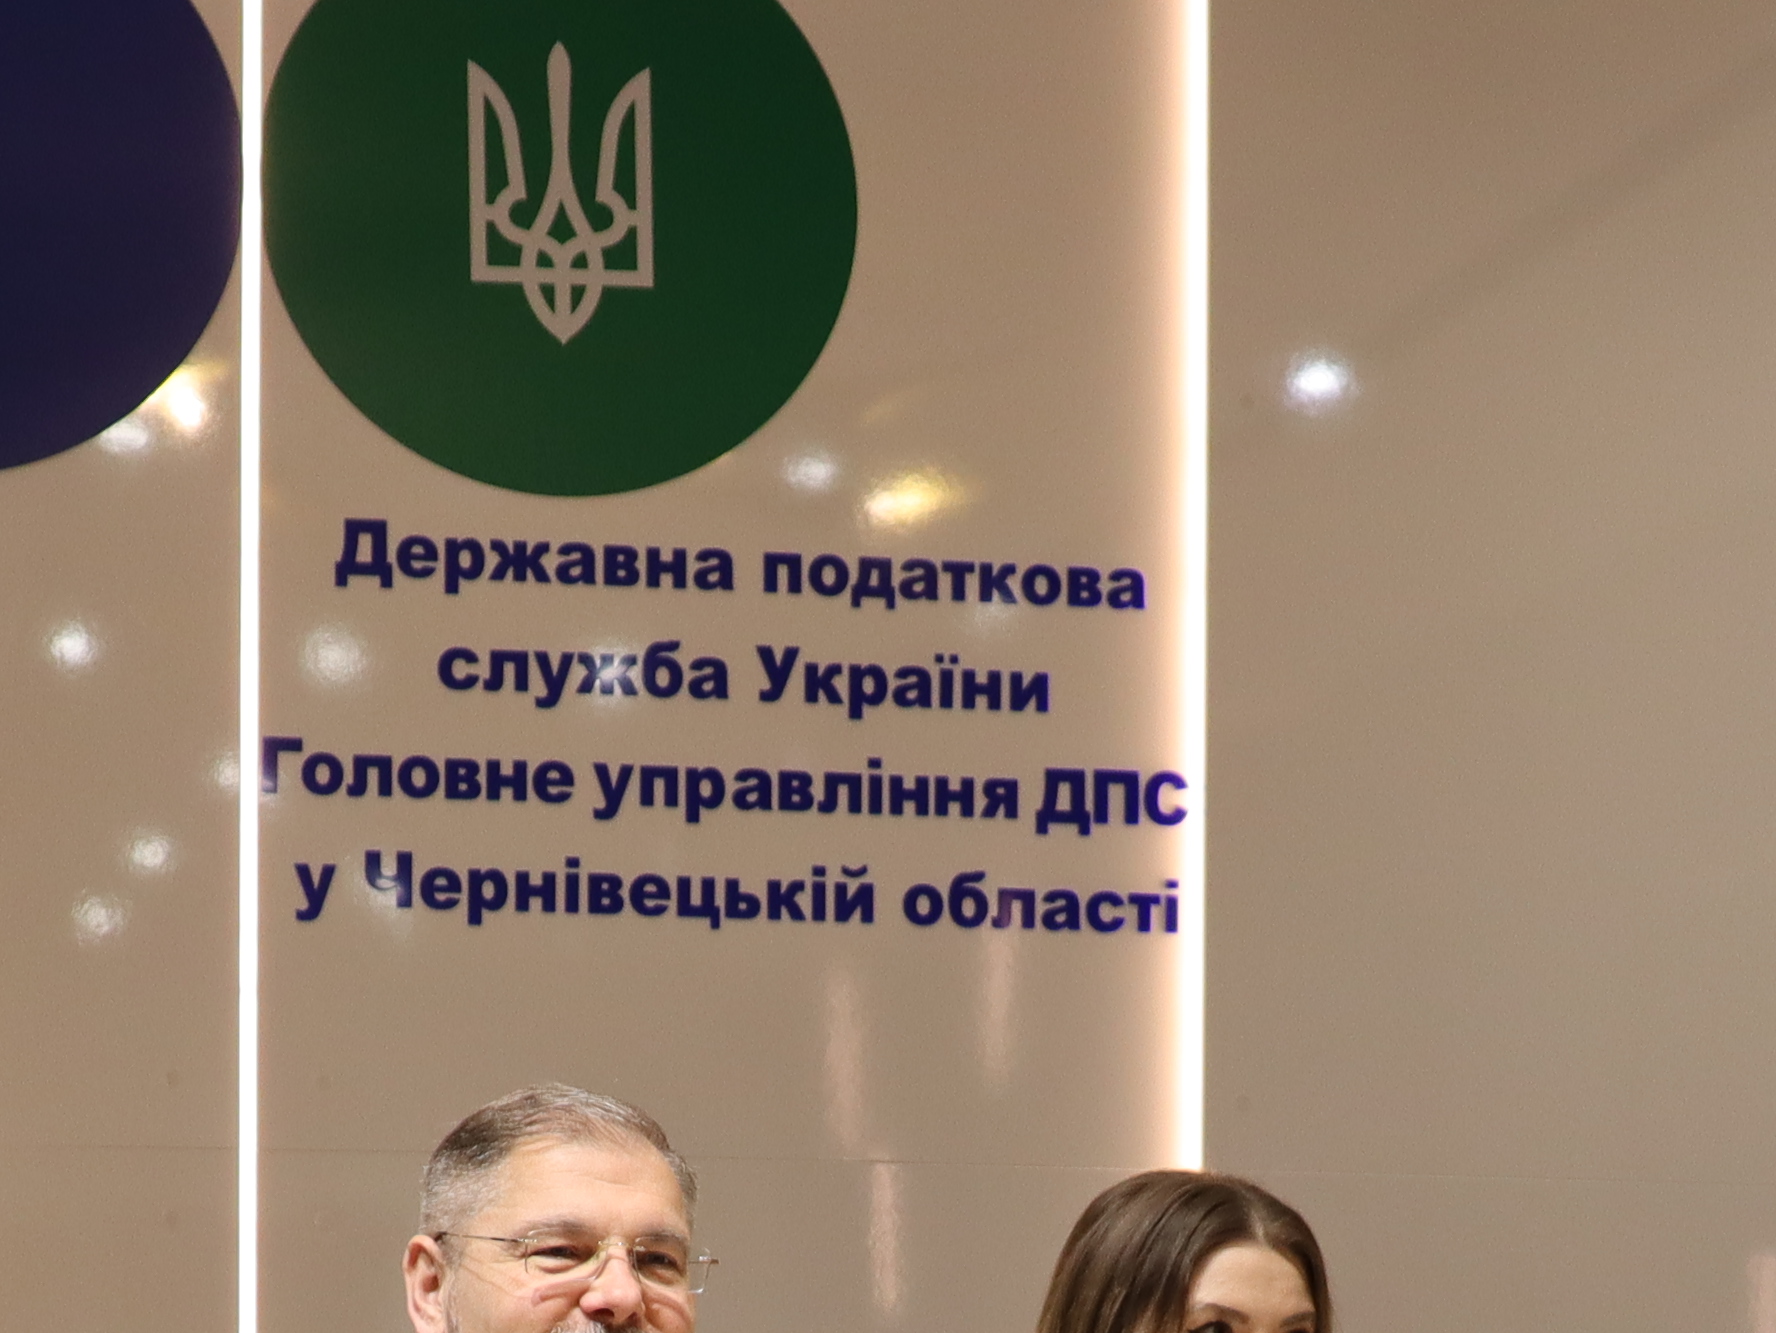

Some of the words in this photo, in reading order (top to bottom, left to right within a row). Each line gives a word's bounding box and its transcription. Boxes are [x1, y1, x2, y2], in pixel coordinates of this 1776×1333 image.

[334, 517, 735, 593] Державна
[761, 550, 1147, 610] податкова
[437, 640, 729, 709] служба
[755, 644, 1050, 720] України
[261, 735, 575, 803] Головне
[592, 757, 1020, 832] управління
[1035, 767, 1189, 836] ДПС
[293, 862, 337, 922] у
[364, 849, 875, 930] Чернівецькій
[902, 870, 1180, 933] області
